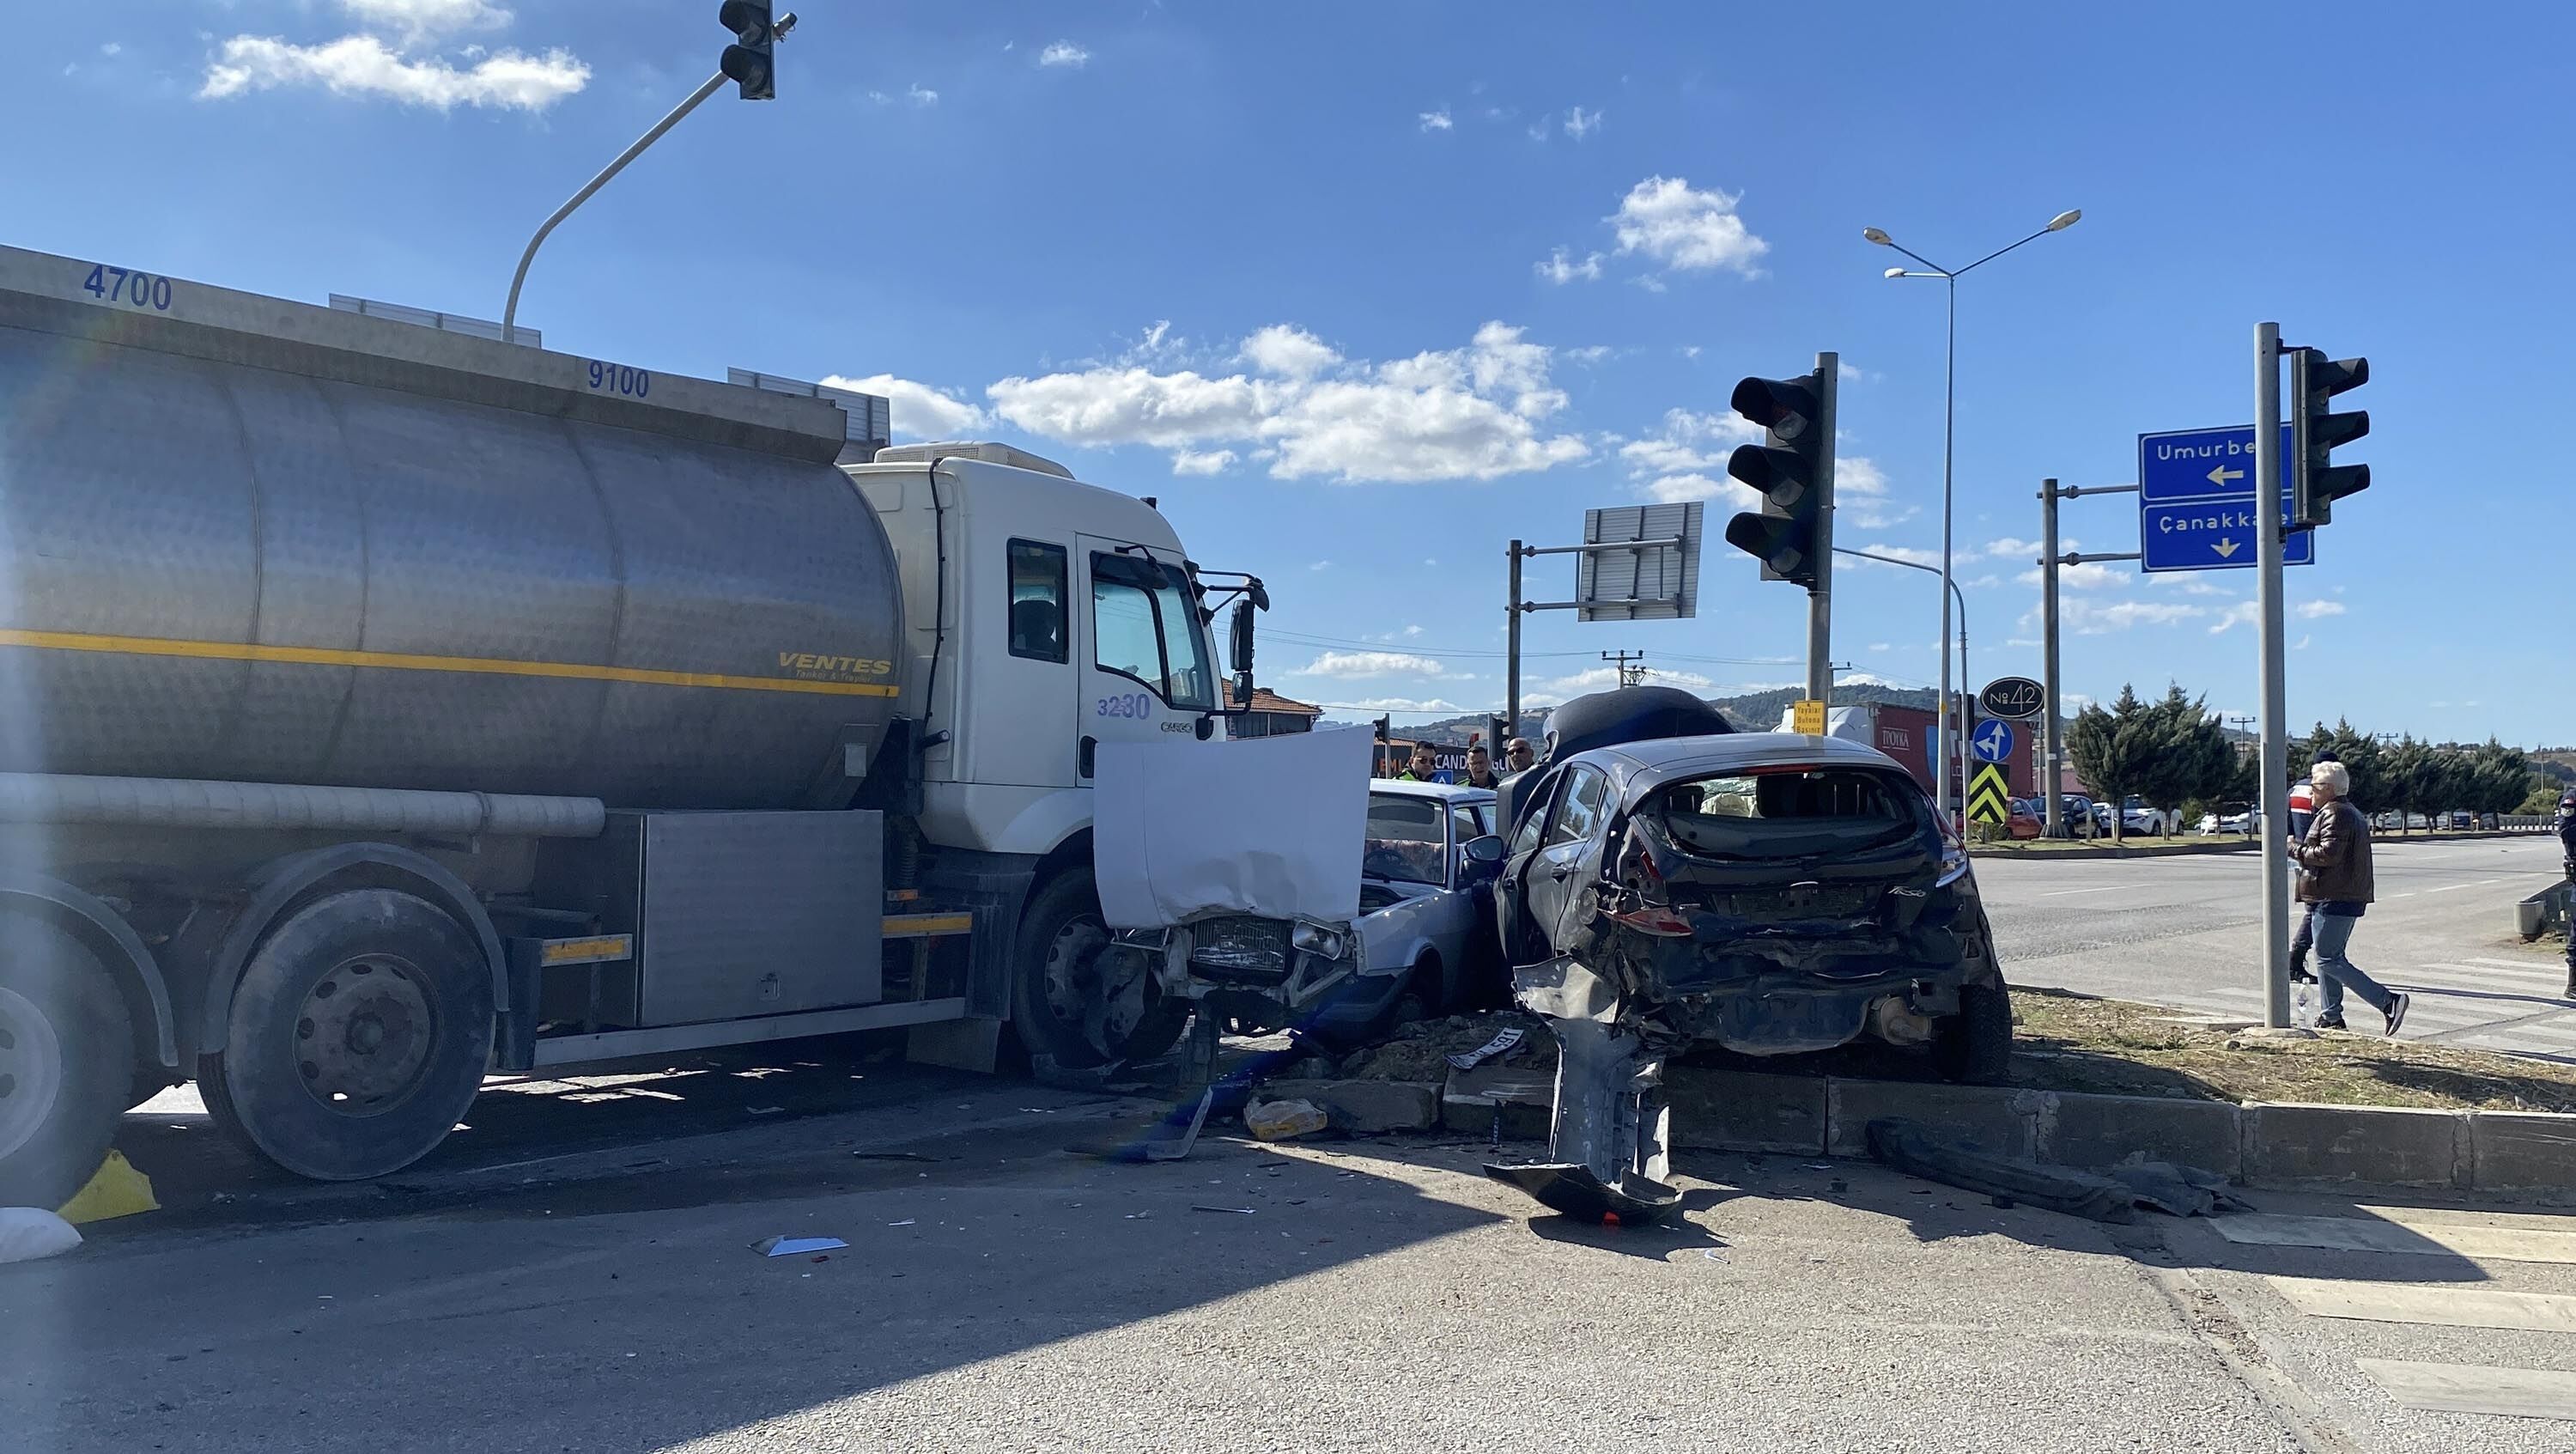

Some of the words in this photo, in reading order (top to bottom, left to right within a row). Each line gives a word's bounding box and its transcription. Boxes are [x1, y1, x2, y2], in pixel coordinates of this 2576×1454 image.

[84, 265, 172, 310] 4700
[589, 360, 649, 398] 9100
[2157, 440, 2256, 460] Umurbe
[779, 652, 892, 674] VENTES
[1160, 721, 1193, 733] CARGO
